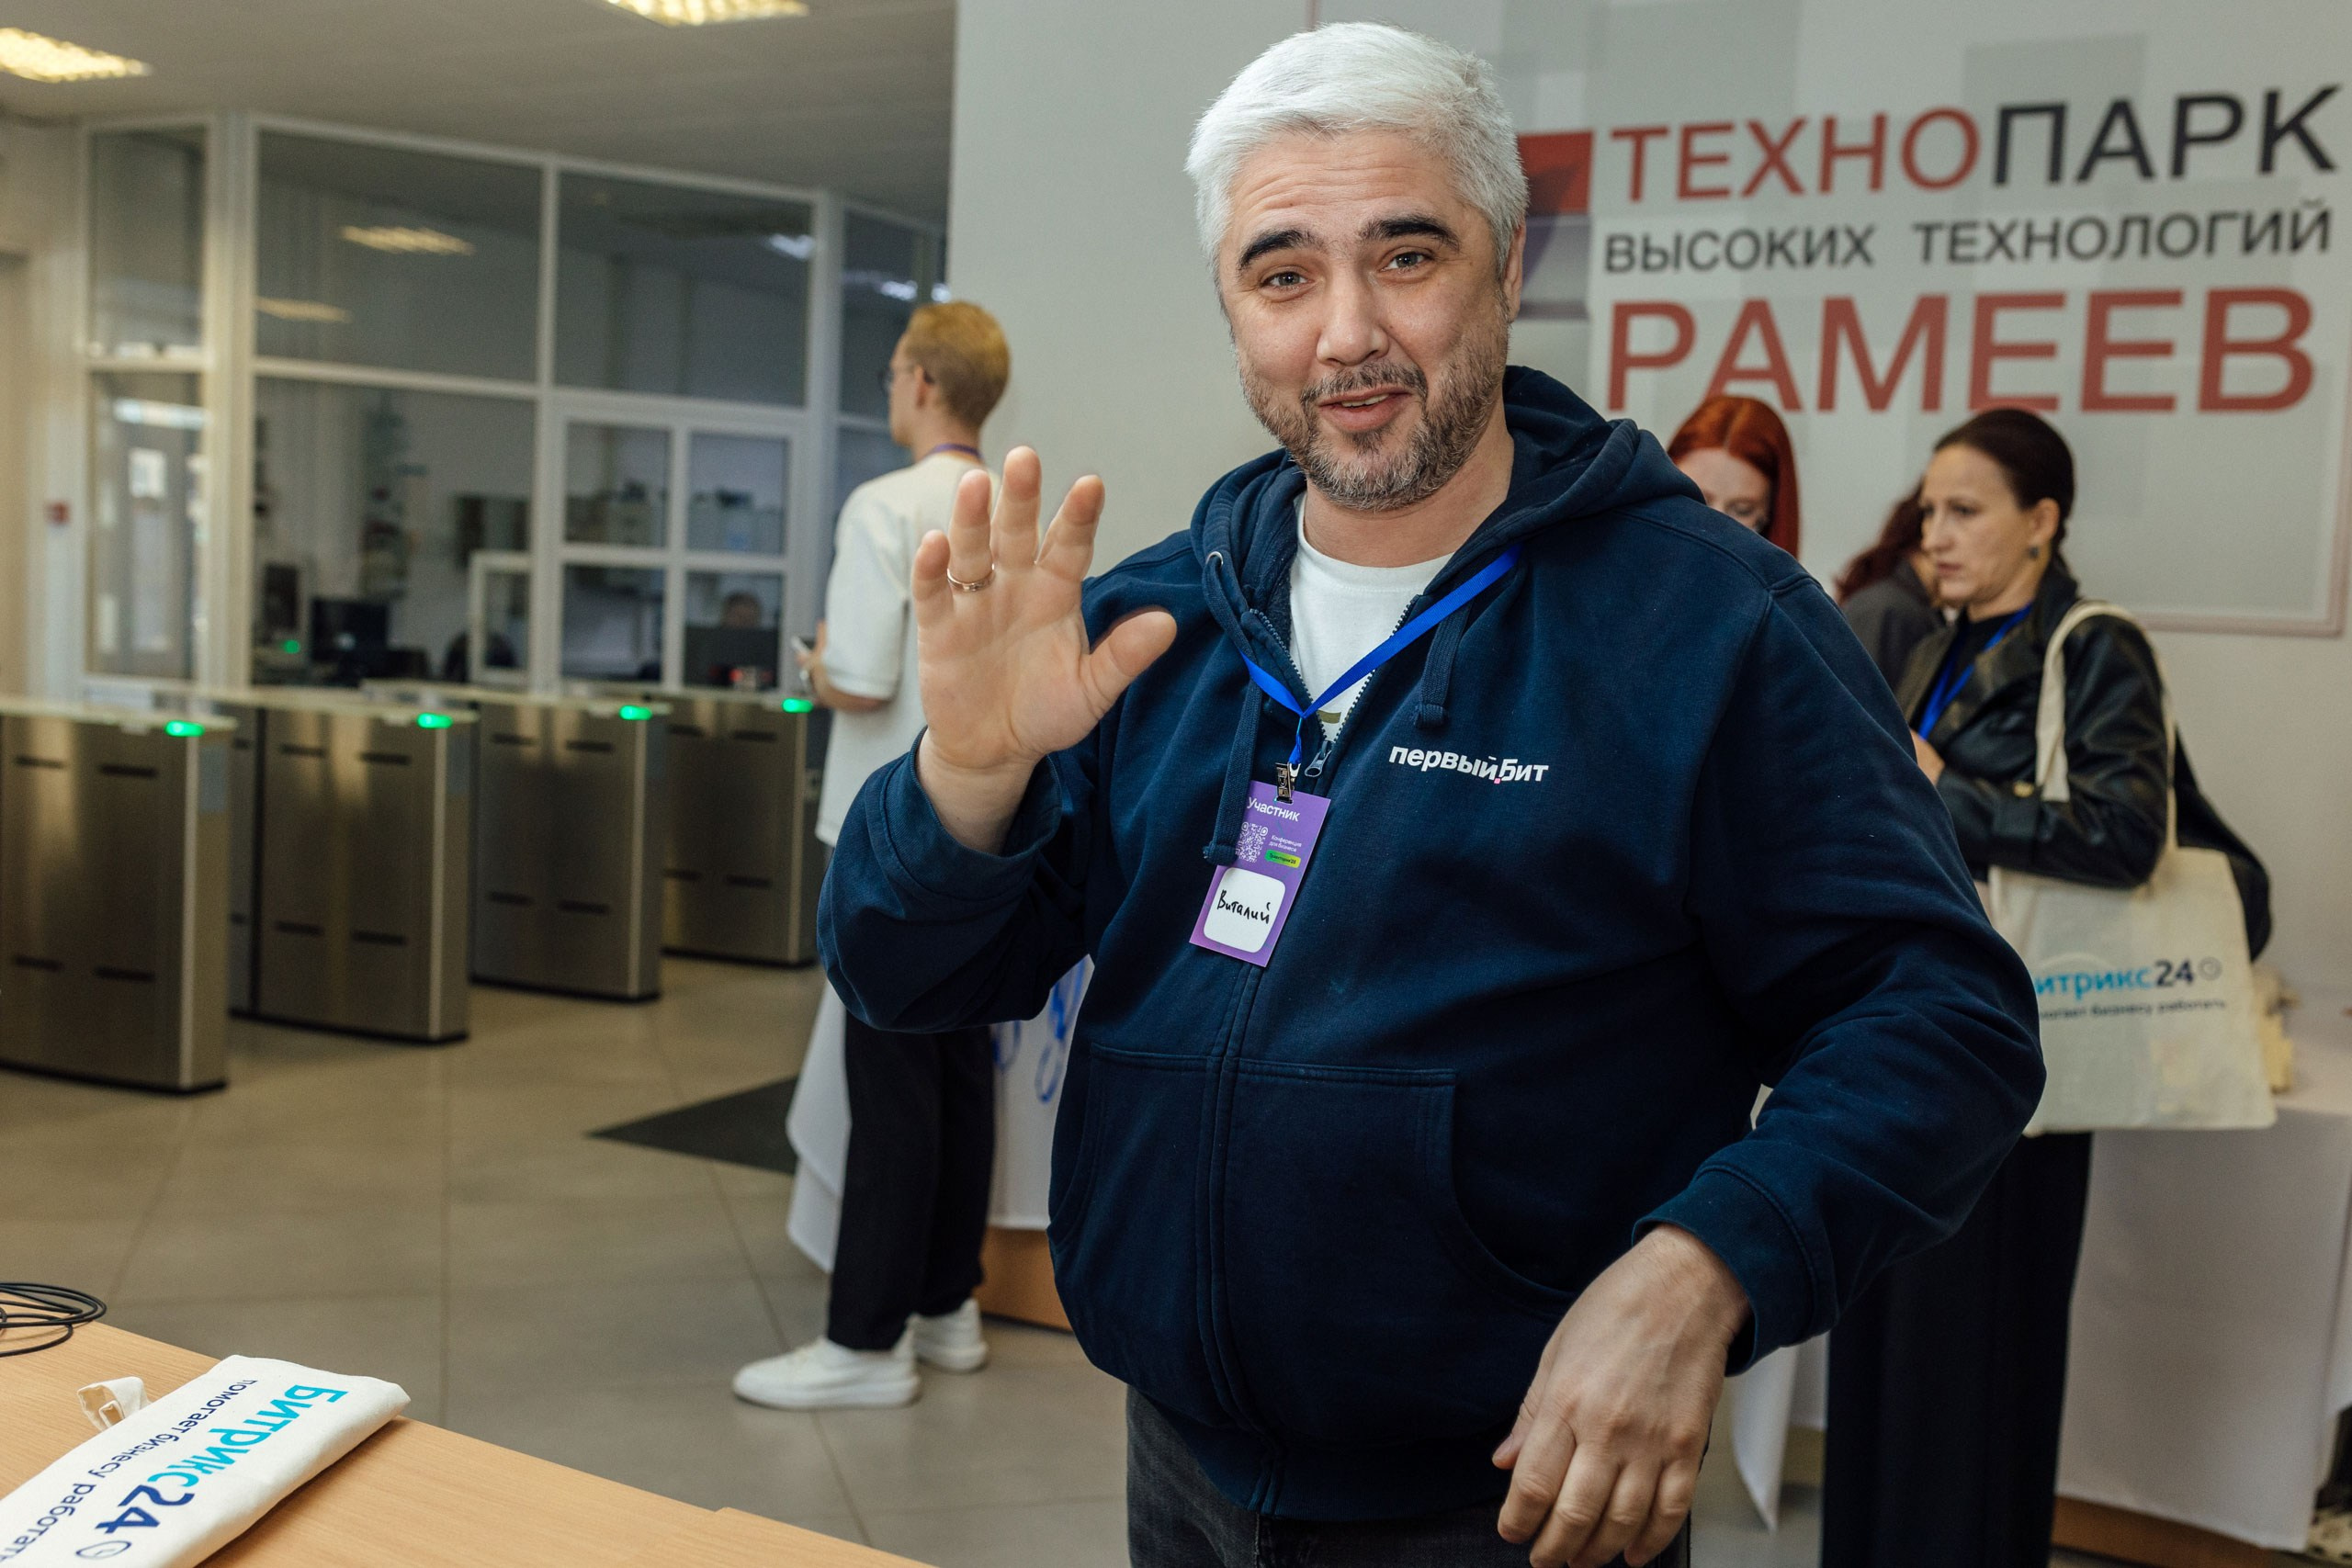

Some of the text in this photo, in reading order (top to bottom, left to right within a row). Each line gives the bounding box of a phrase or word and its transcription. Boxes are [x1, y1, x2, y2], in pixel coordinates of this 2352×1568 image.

[1610, 84, 2343, 202] ТЕХНОПАРК
[1604, 197, 2334, 274] ВЫСОКИХ ТЕХНОЛОГИЙ
[1607, 286, 2316, 416] РАМЕЕВ
[1247, 796, 1300, 822] Участник
[1217, 889, 1271, 924] Виталий
[2033, 958, 2194, 1000] итрикс24
[171, 1380, 258, 1434] помогает
[87, 1433, 180, 1478] бизнесу
[95, 1384, 348, 1535] Битрикс24
